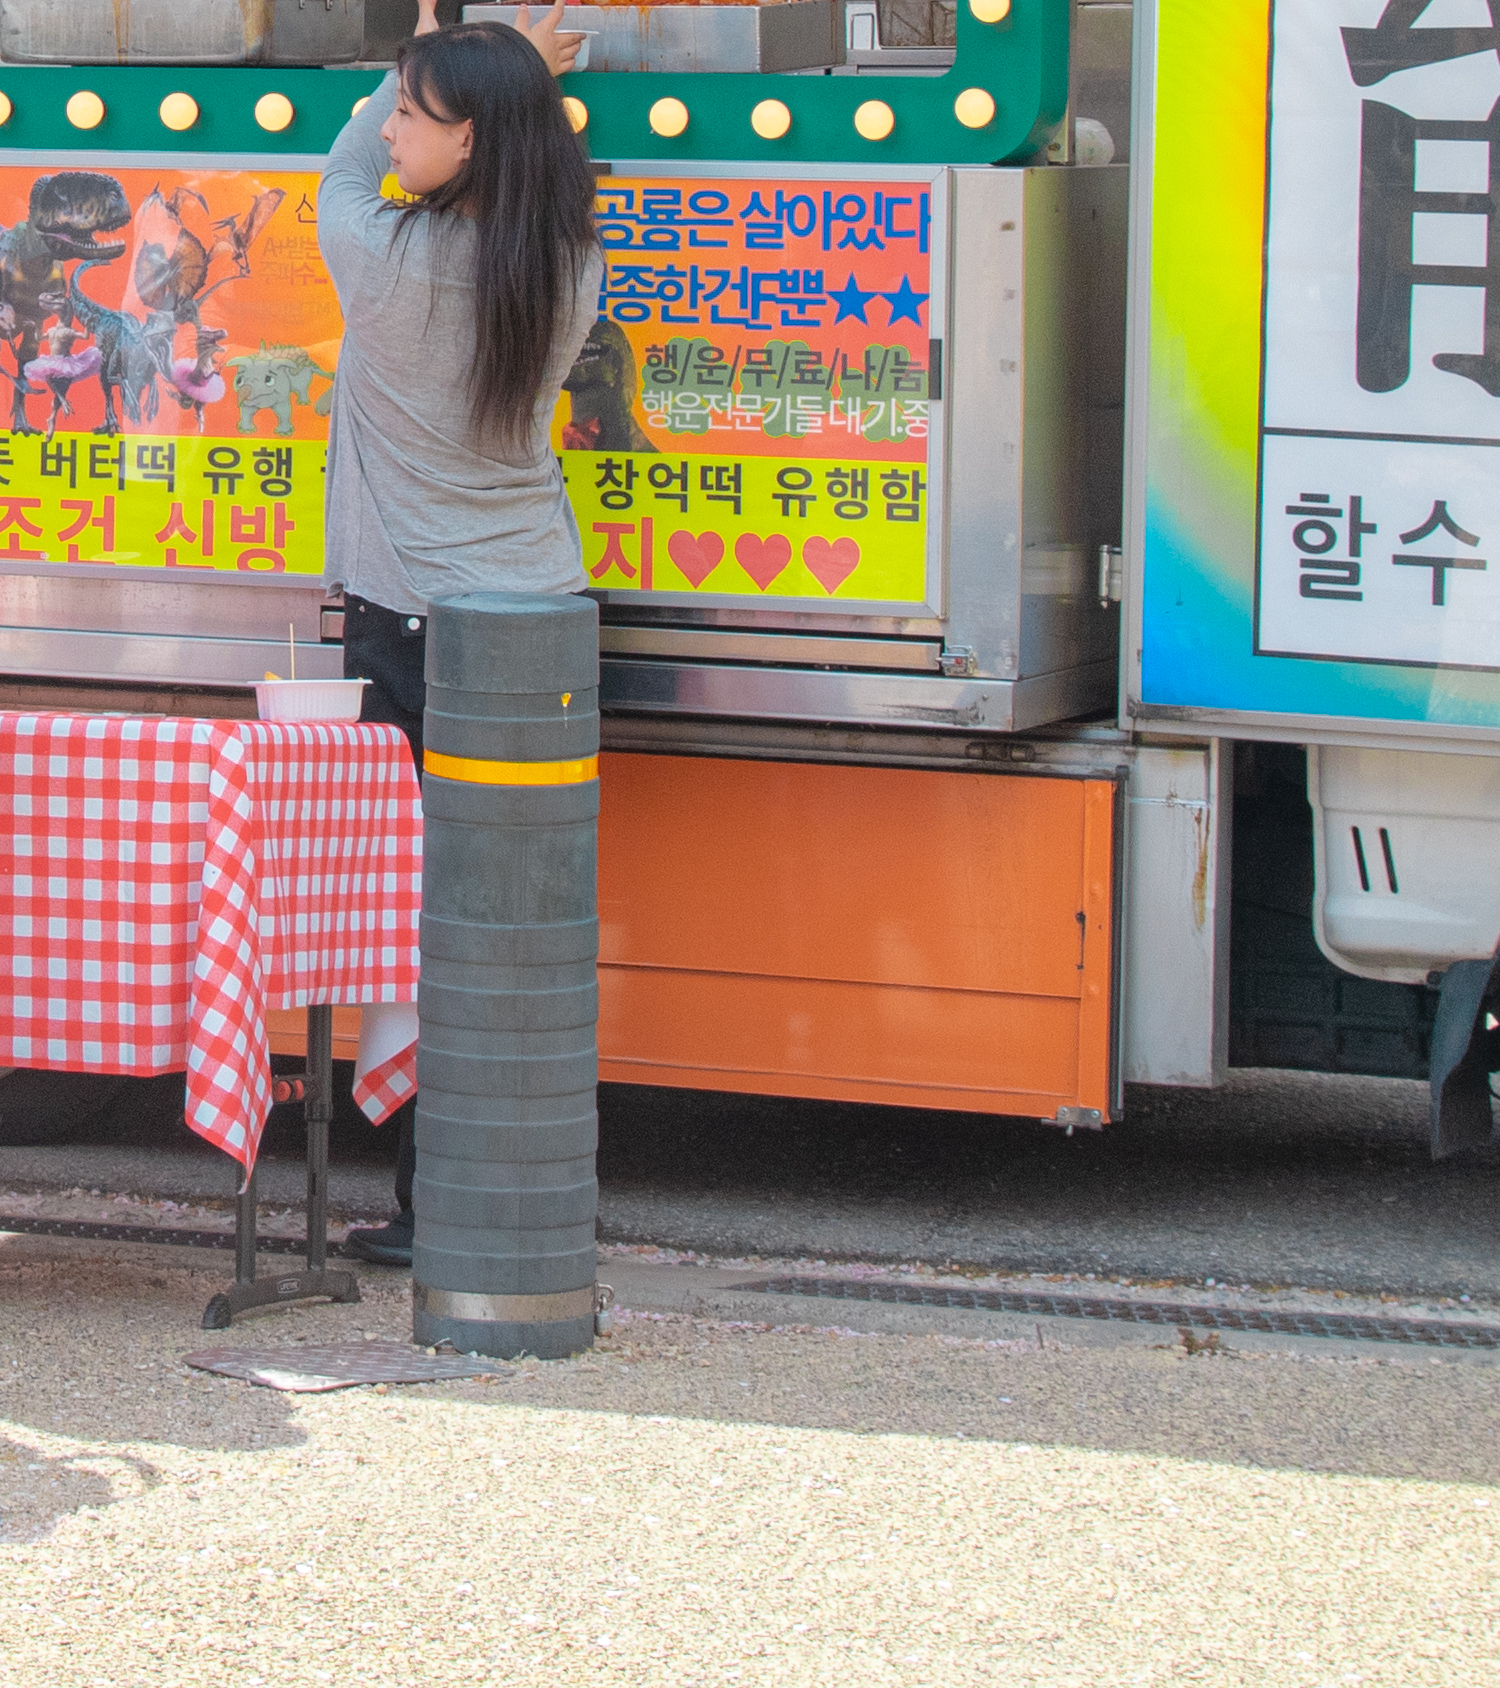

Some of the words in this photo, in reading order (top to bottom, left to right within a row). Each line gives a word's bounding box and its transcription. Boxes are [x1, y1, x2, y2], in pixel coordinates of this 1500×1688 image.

[594, 188, 734, 252] 공룡은
[740, 189, 932, 254] 살아있다
[40, 439, 176, 494] 버터떡
[202, 446, 293, 497] 유행
[594, 457, 742, 515] 창억떡
[772, 466, 927, 522] 유행함
[154, 498, 297, 573] 신방
